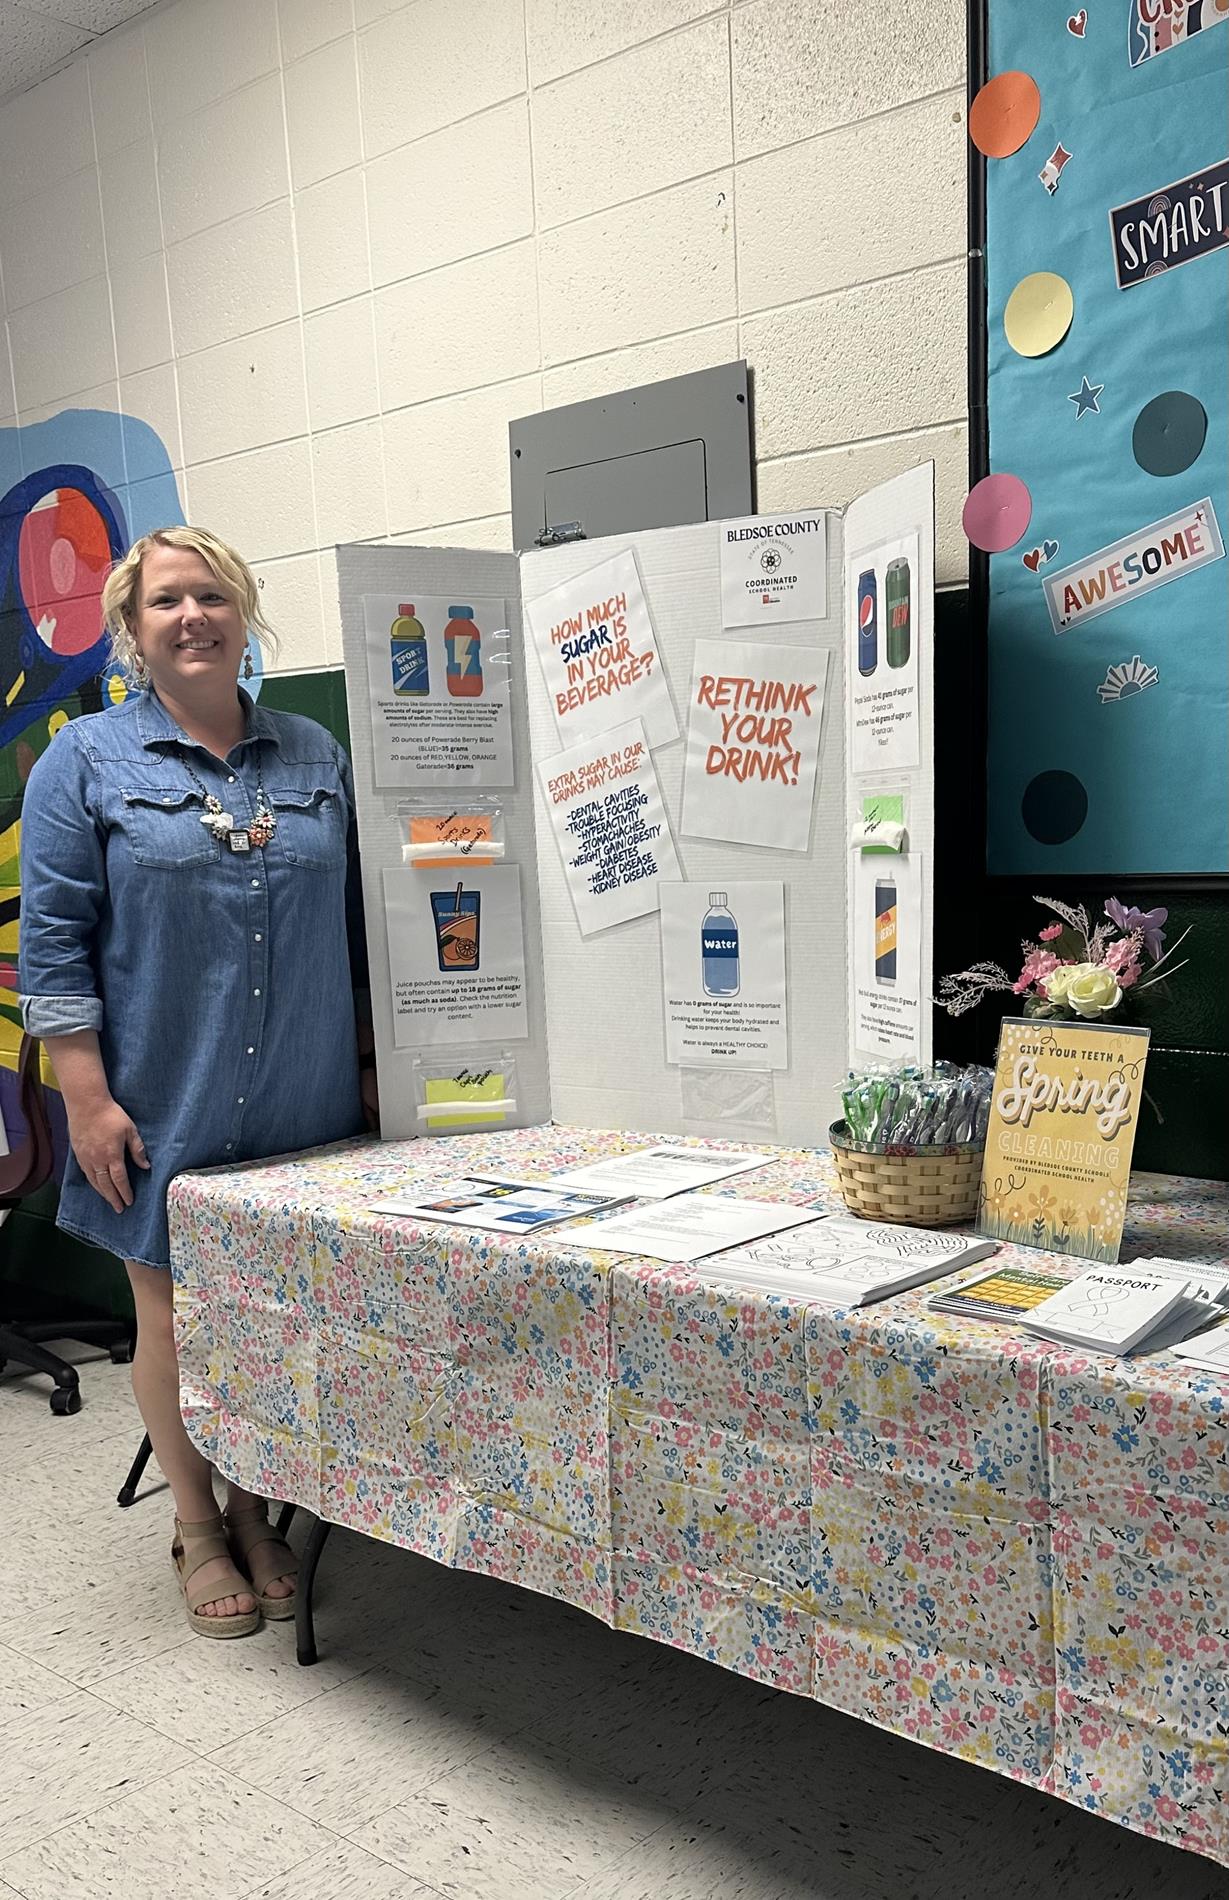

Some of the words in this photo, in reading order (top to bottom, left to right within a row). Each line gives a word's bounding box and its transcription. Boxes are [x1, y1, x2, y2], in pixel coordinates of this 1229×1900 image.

[1120, 181, 1228, 271] SMART
[727, 526, 773, 542] BLEDSOE
[775, 519, 821, 536] COUNTY
[748, 545, 760, 560] STATE
[769, 539, 795, 554] TENNESSEE
[745, 576, 798, 588] COORDINATED
[1064, 523, 1205, 614] AWESOME
[551, 612, 583, 645] HOW
[586, 592, 626, 629] MUCH
[561, 625, 613, 664] SUGAR
[613, 616, 627, 639] IS
[396, 648, 421, 665] SPORT
[399, 657, 423, 674] DRINK
[567, 660, 584, 686] IN
[587, 638, 635, 676] YOUR
[556, 651, 654, 716] BEVERAGE?
[698, 675, 818, 717] RETHINK
[722, 713, 793, 754] YOUR
[548, 771, 577, 793] EXTRA
[578, 757, 611, 780] SUGAR
[611, 752, 621, 766] IN
[624, 742, 646, 760] OUR
[553, 780, 585, 804] DRINKS
[587, 772, 605, 791] MAY
[608, 759, 642, 780] CAUSE:
[706, 745, 801, 786] DRINK!
[565, 811, 605, 834] -TROUBLE
[607, 794, 649, 817] FOCUSING
[567, 800, 603, 821] -DENTAL
[605, 784, 640, 806] CAVITIES
[577, 808, 640, 840] -HYPERACTIVITY
[578, 819, 646, 852] -STOMACHACHES
[569, 849, 601, 869] -WEIGHT
[588, 866, 618, 884] -HEART
[619, 852, 654, 874] DISEASE
[596, 846, 639, 869] -DIABETES
[589, 877, 621, 895] -KIDNEY
[624, 863, 658, 884] DISEASE
[414, 980, 441, 988] pouches
[477, 985, 496, 993] grams
[447, 1004, 468, 1012] option
[1020, 1045, 1045, 1056] GIVE
[1049, 1047, 1077, 1059] YOUR
[1081, 1051, 1113, 1063] TEETH
[1117, 1054, 1124, 1064] A
[997, 1056, 1132, 1142] Spring
[998, 1130, 1120, 1169] CLEANING
[1003, 1155, 1029, 1166] PROVIDED
[1038, 1161, 1061, 1170] BLEDSOE
[1062, 1165, 1083, 1173] COUNTY
[1015, 1166, 1051, 1176] COORDINATED
[1052, 1171, 1073, 1180] SCHOOL
[1074, 1174, 1095, 1183] HEALTH
[998, 1273, 1039, 1285] Mental
[1086, 1274, 1164, 1293] PASSPORT
